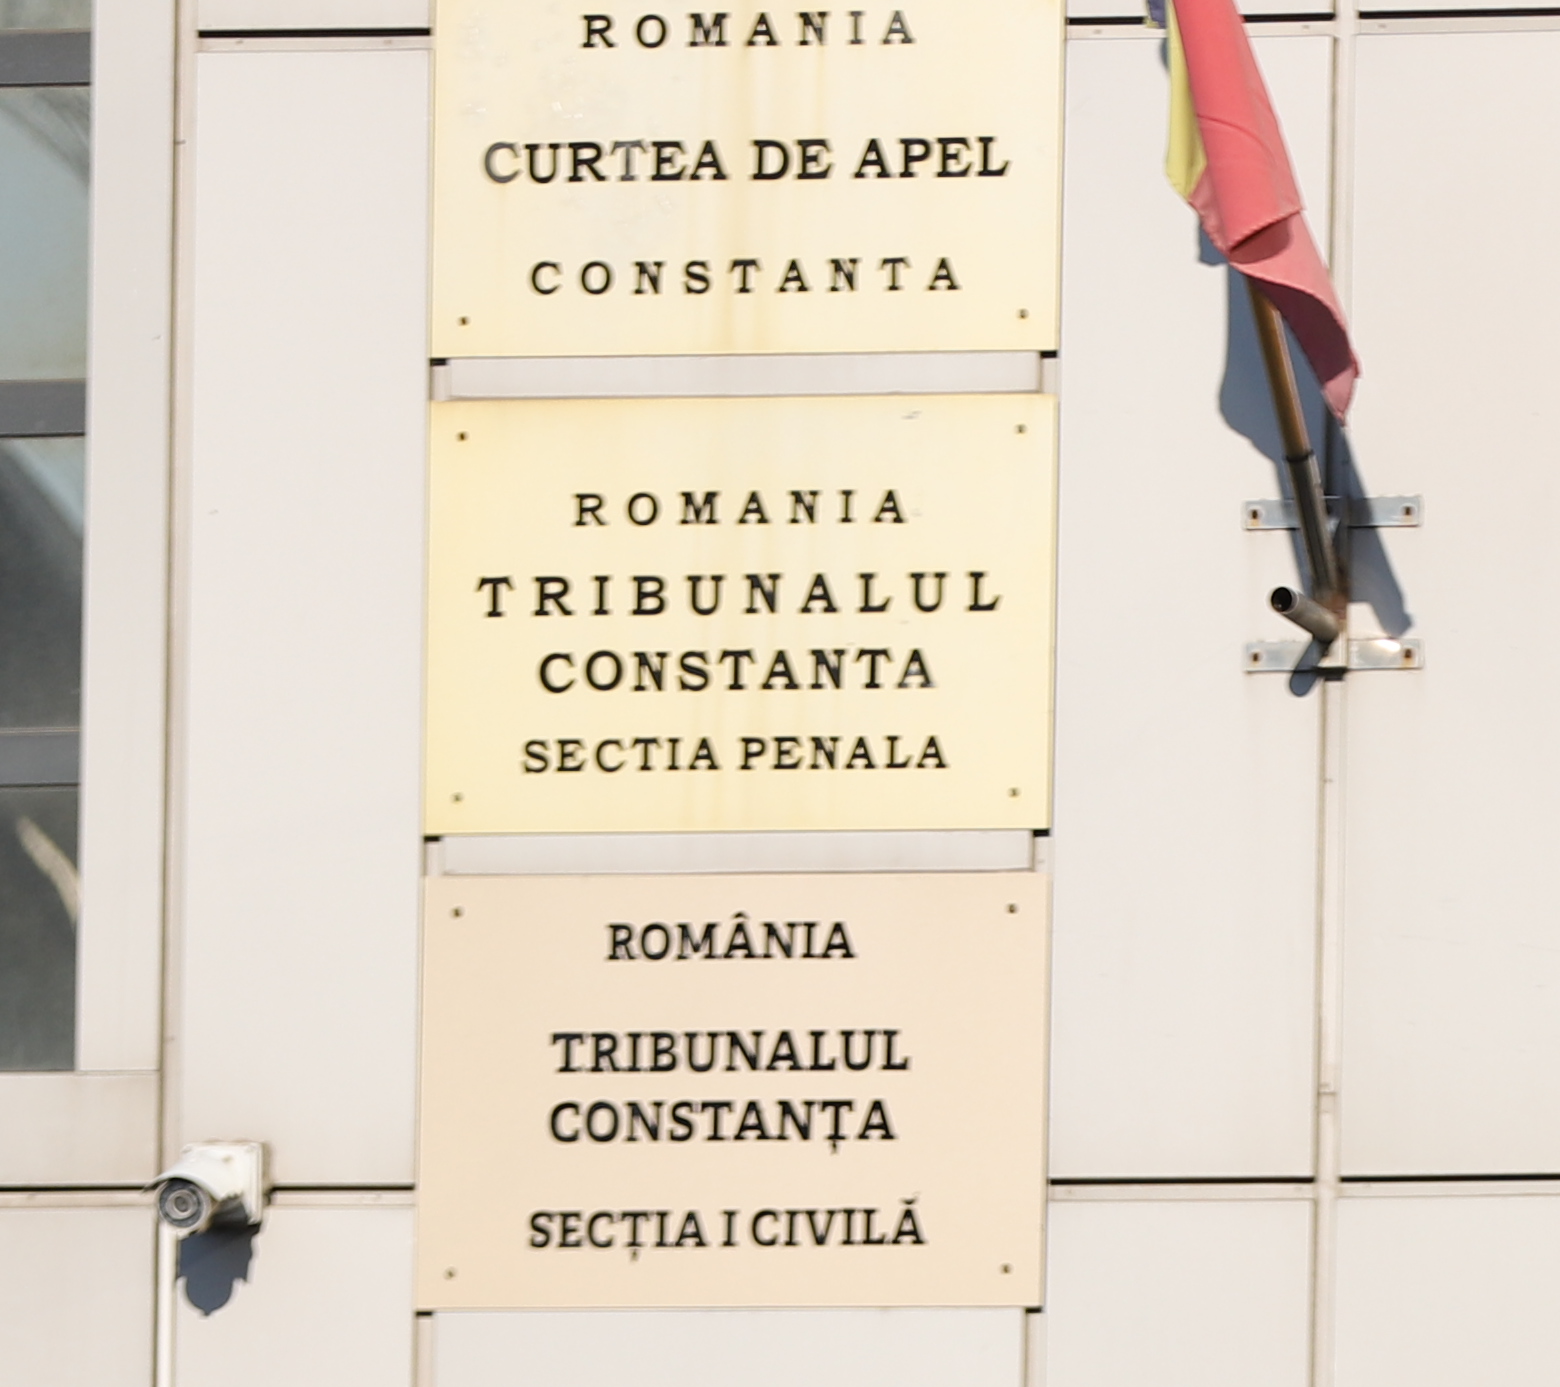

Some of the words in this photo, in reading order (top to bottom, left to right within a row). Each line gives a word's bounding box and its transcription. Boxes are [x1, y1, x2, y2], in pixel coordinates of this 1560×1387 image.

[581, 11, 915, 50] ROMANIA
[483, 139, 729, 185] CURTEA
[751, 138, 833, 182] DE
[852, 136, 1011, 180] APEL
[530, 256, 961, 296] CONSTANTA
[573, 488, 908, 527] ROMANIA
[477, 570, 1001, 619] TRIBUNALUL
[538, 648, 935, 695] CONSTANTA
[522, 737, 720, 774] SECTIA
[739, 735, 949, 771] PENALA
[606, 910, 856, 961] ROMÂNIA
[551, 1028, 911, 1074] TRIBUNALUL
[549, 1099, 896, 1153] CONSTANȚA
[529, 1209, 707, 1260] SECȚIA
[720, 1210, 739, 1247] I
[751, 1198, 926, 1247] CIVILĂ
